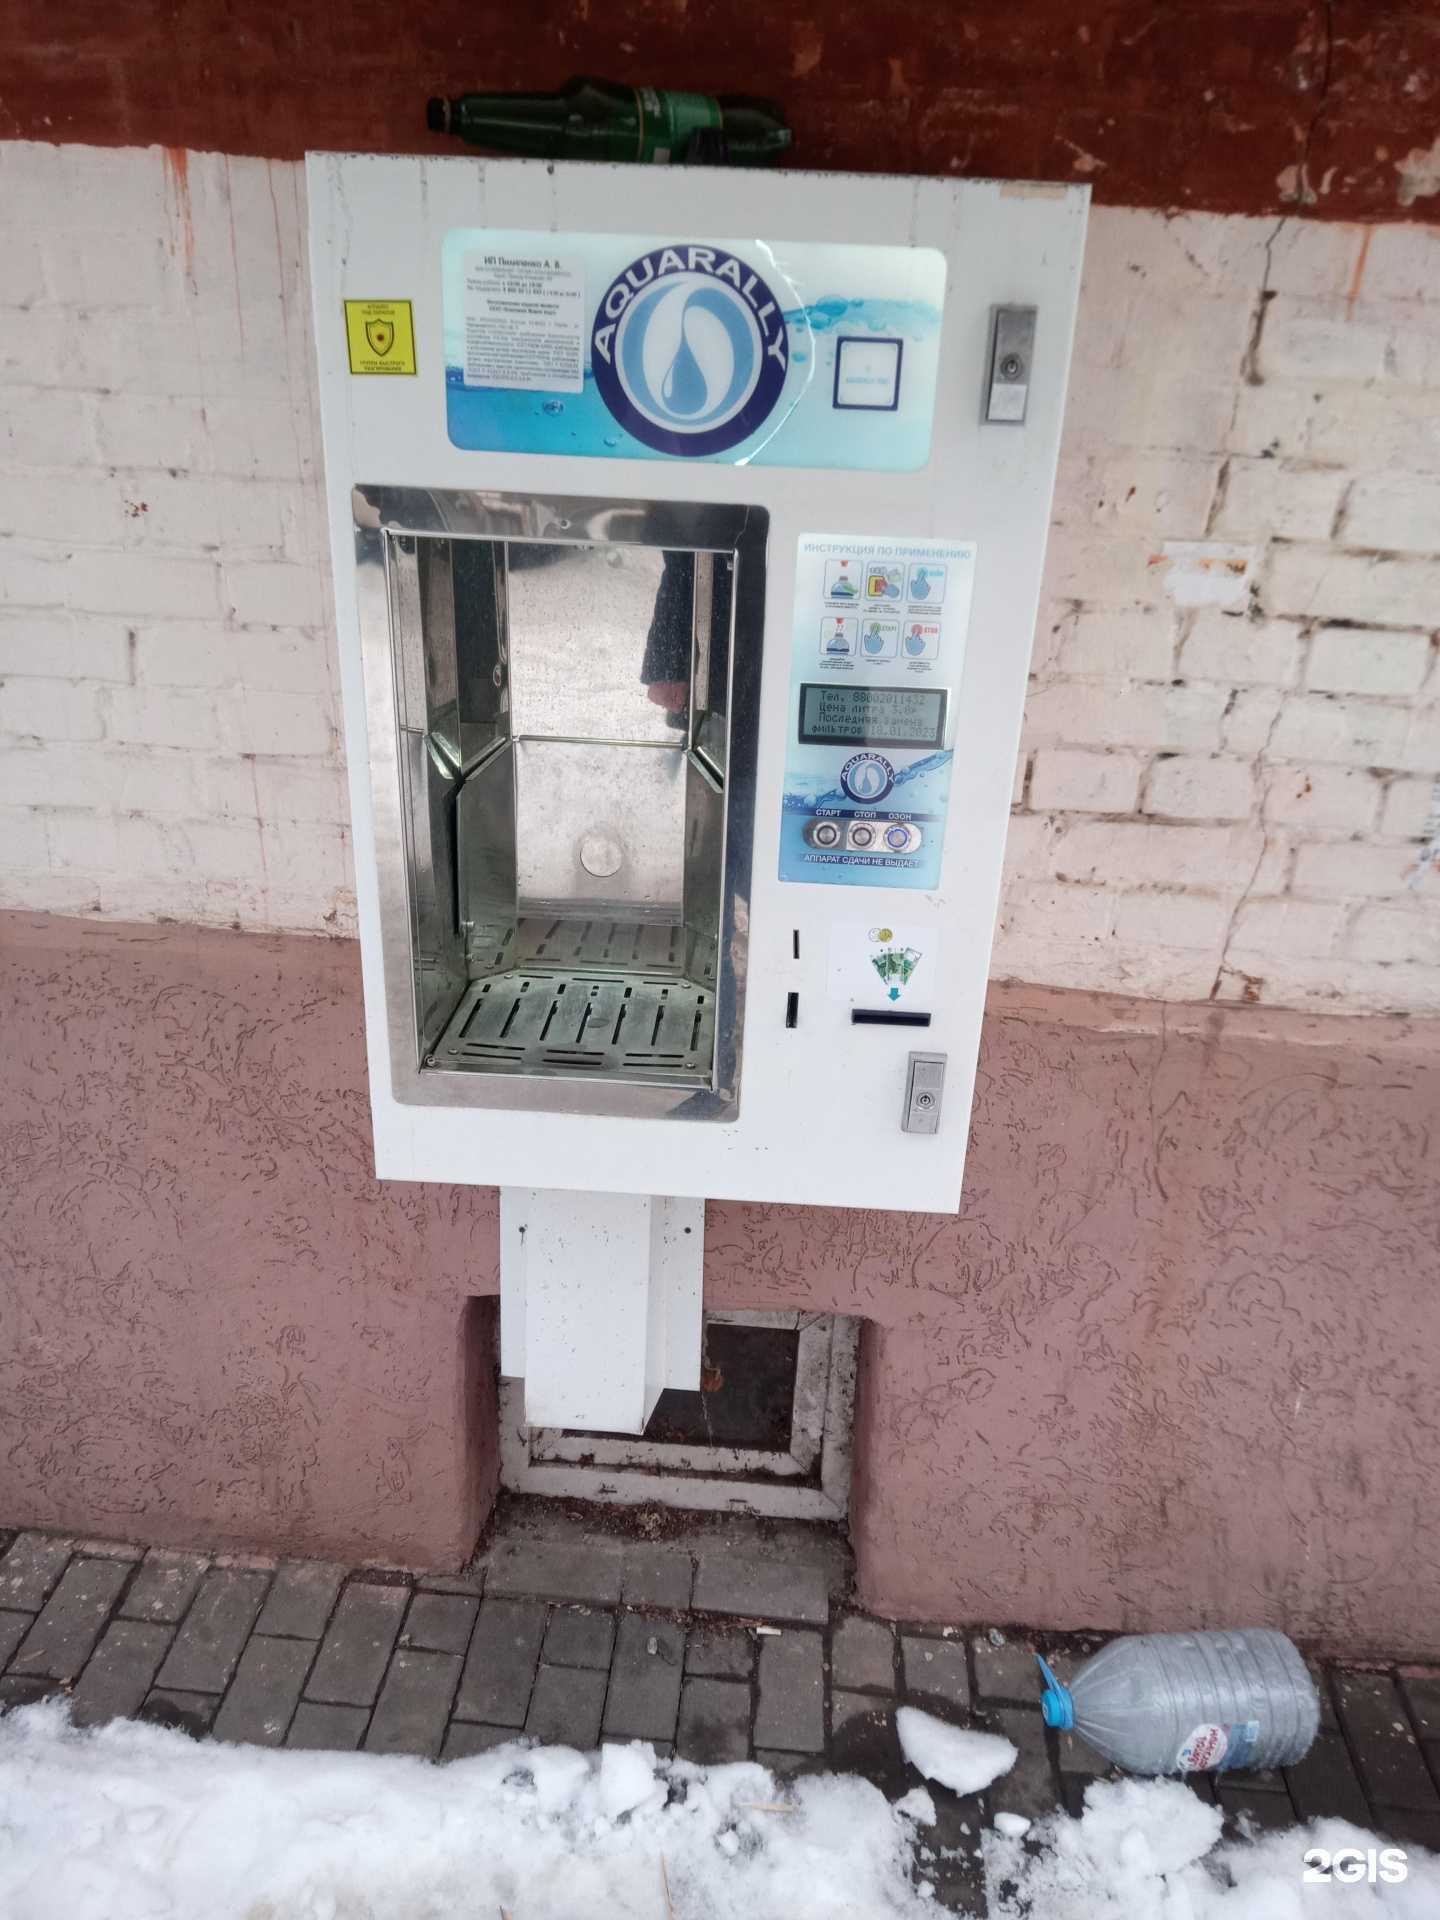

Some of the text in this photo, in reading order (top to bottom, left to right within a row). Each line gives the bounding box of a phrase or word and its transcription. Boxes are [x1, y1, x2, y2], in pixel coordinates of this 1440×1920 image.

[595, 247, 786, 372] AQUARALLY
[804, 543, 971, 559] ИНСТРУКЦИЯ ПО ПРИМЕНЕНИЮ
[841, 752, 895, 784] AQUARALLY
[815, 808, 912, 821] СТАРТ СТОП ОЗОН
[804, 854, 841, 863] АППАРАТ
[842, 856, 870, 865] СДАЧИ
[872, 858, 884, 866] НЕ
